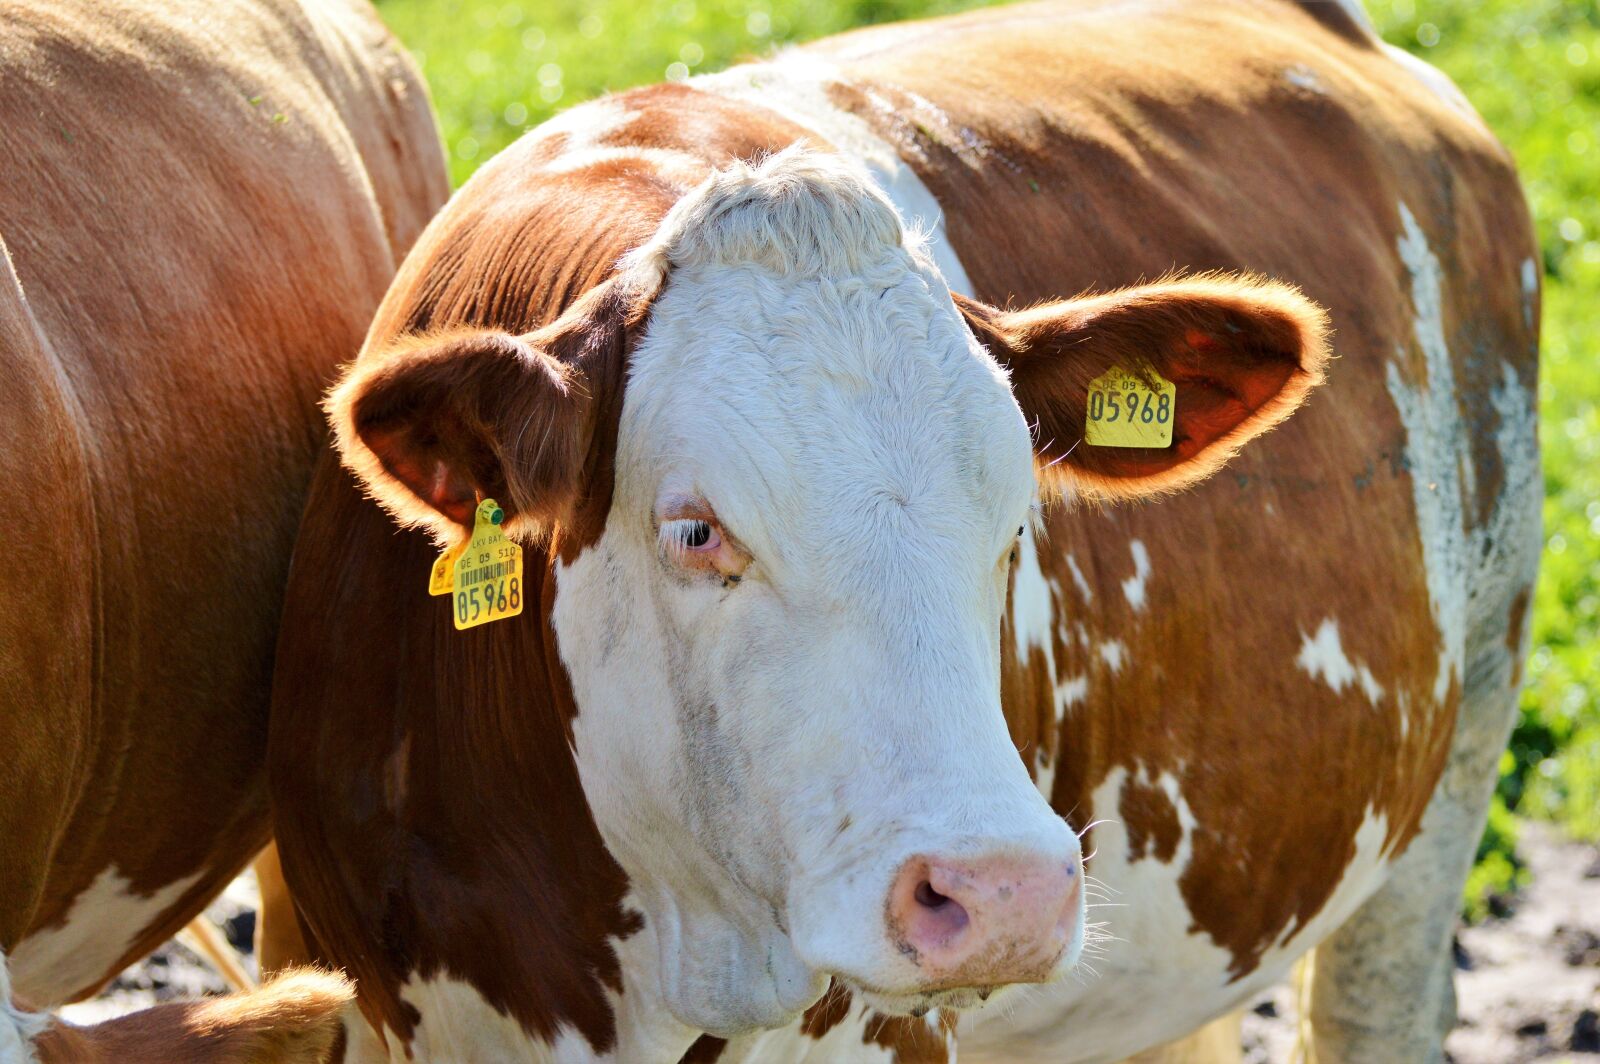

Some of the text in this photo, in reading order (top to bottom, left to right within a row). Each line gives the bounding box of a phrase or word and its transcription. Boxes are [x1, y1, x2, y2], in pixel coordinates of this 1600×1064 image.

[1103, 380, 1162, 391] DE 09 50
[1090, 390, 1170, 424] 05968
[472, 538, 486, 549] LKV
[461, 546, 516, 570] DE 09 510
[457, 577, 520, 624] 05968
